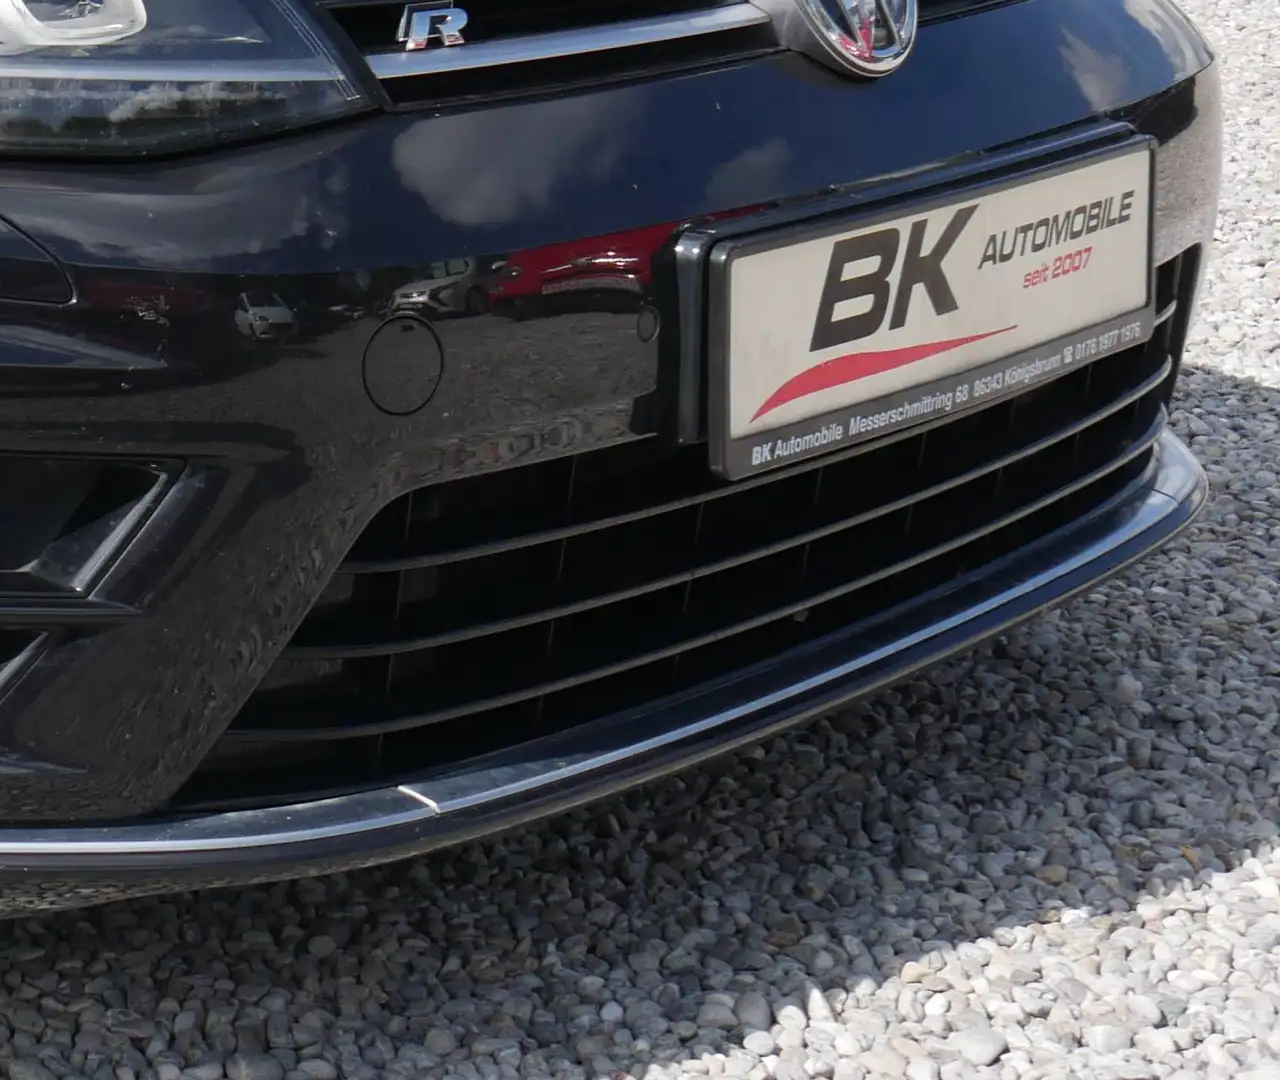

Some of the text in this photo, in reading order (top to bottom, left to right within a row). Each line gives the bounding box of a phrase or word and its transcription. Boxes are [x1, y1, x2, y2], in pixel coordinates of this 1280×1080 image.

[396, 0, 469, 52] R
[978, 190, 1134, 270] AUTOMOBILE
[1023, 246, 1093, 289] seit 2007
[809, 203, 980, 352] BK
[751, 441, 773, 466] BK
[773, 424, 844, 459] Automobile
[848, 389, 953, 437] Messerschmittring
[955, 384, 969, 403] 68
[973, 371, 1003, 397] 86343
[1004, 353, 1063, 388] Königsbrunn
